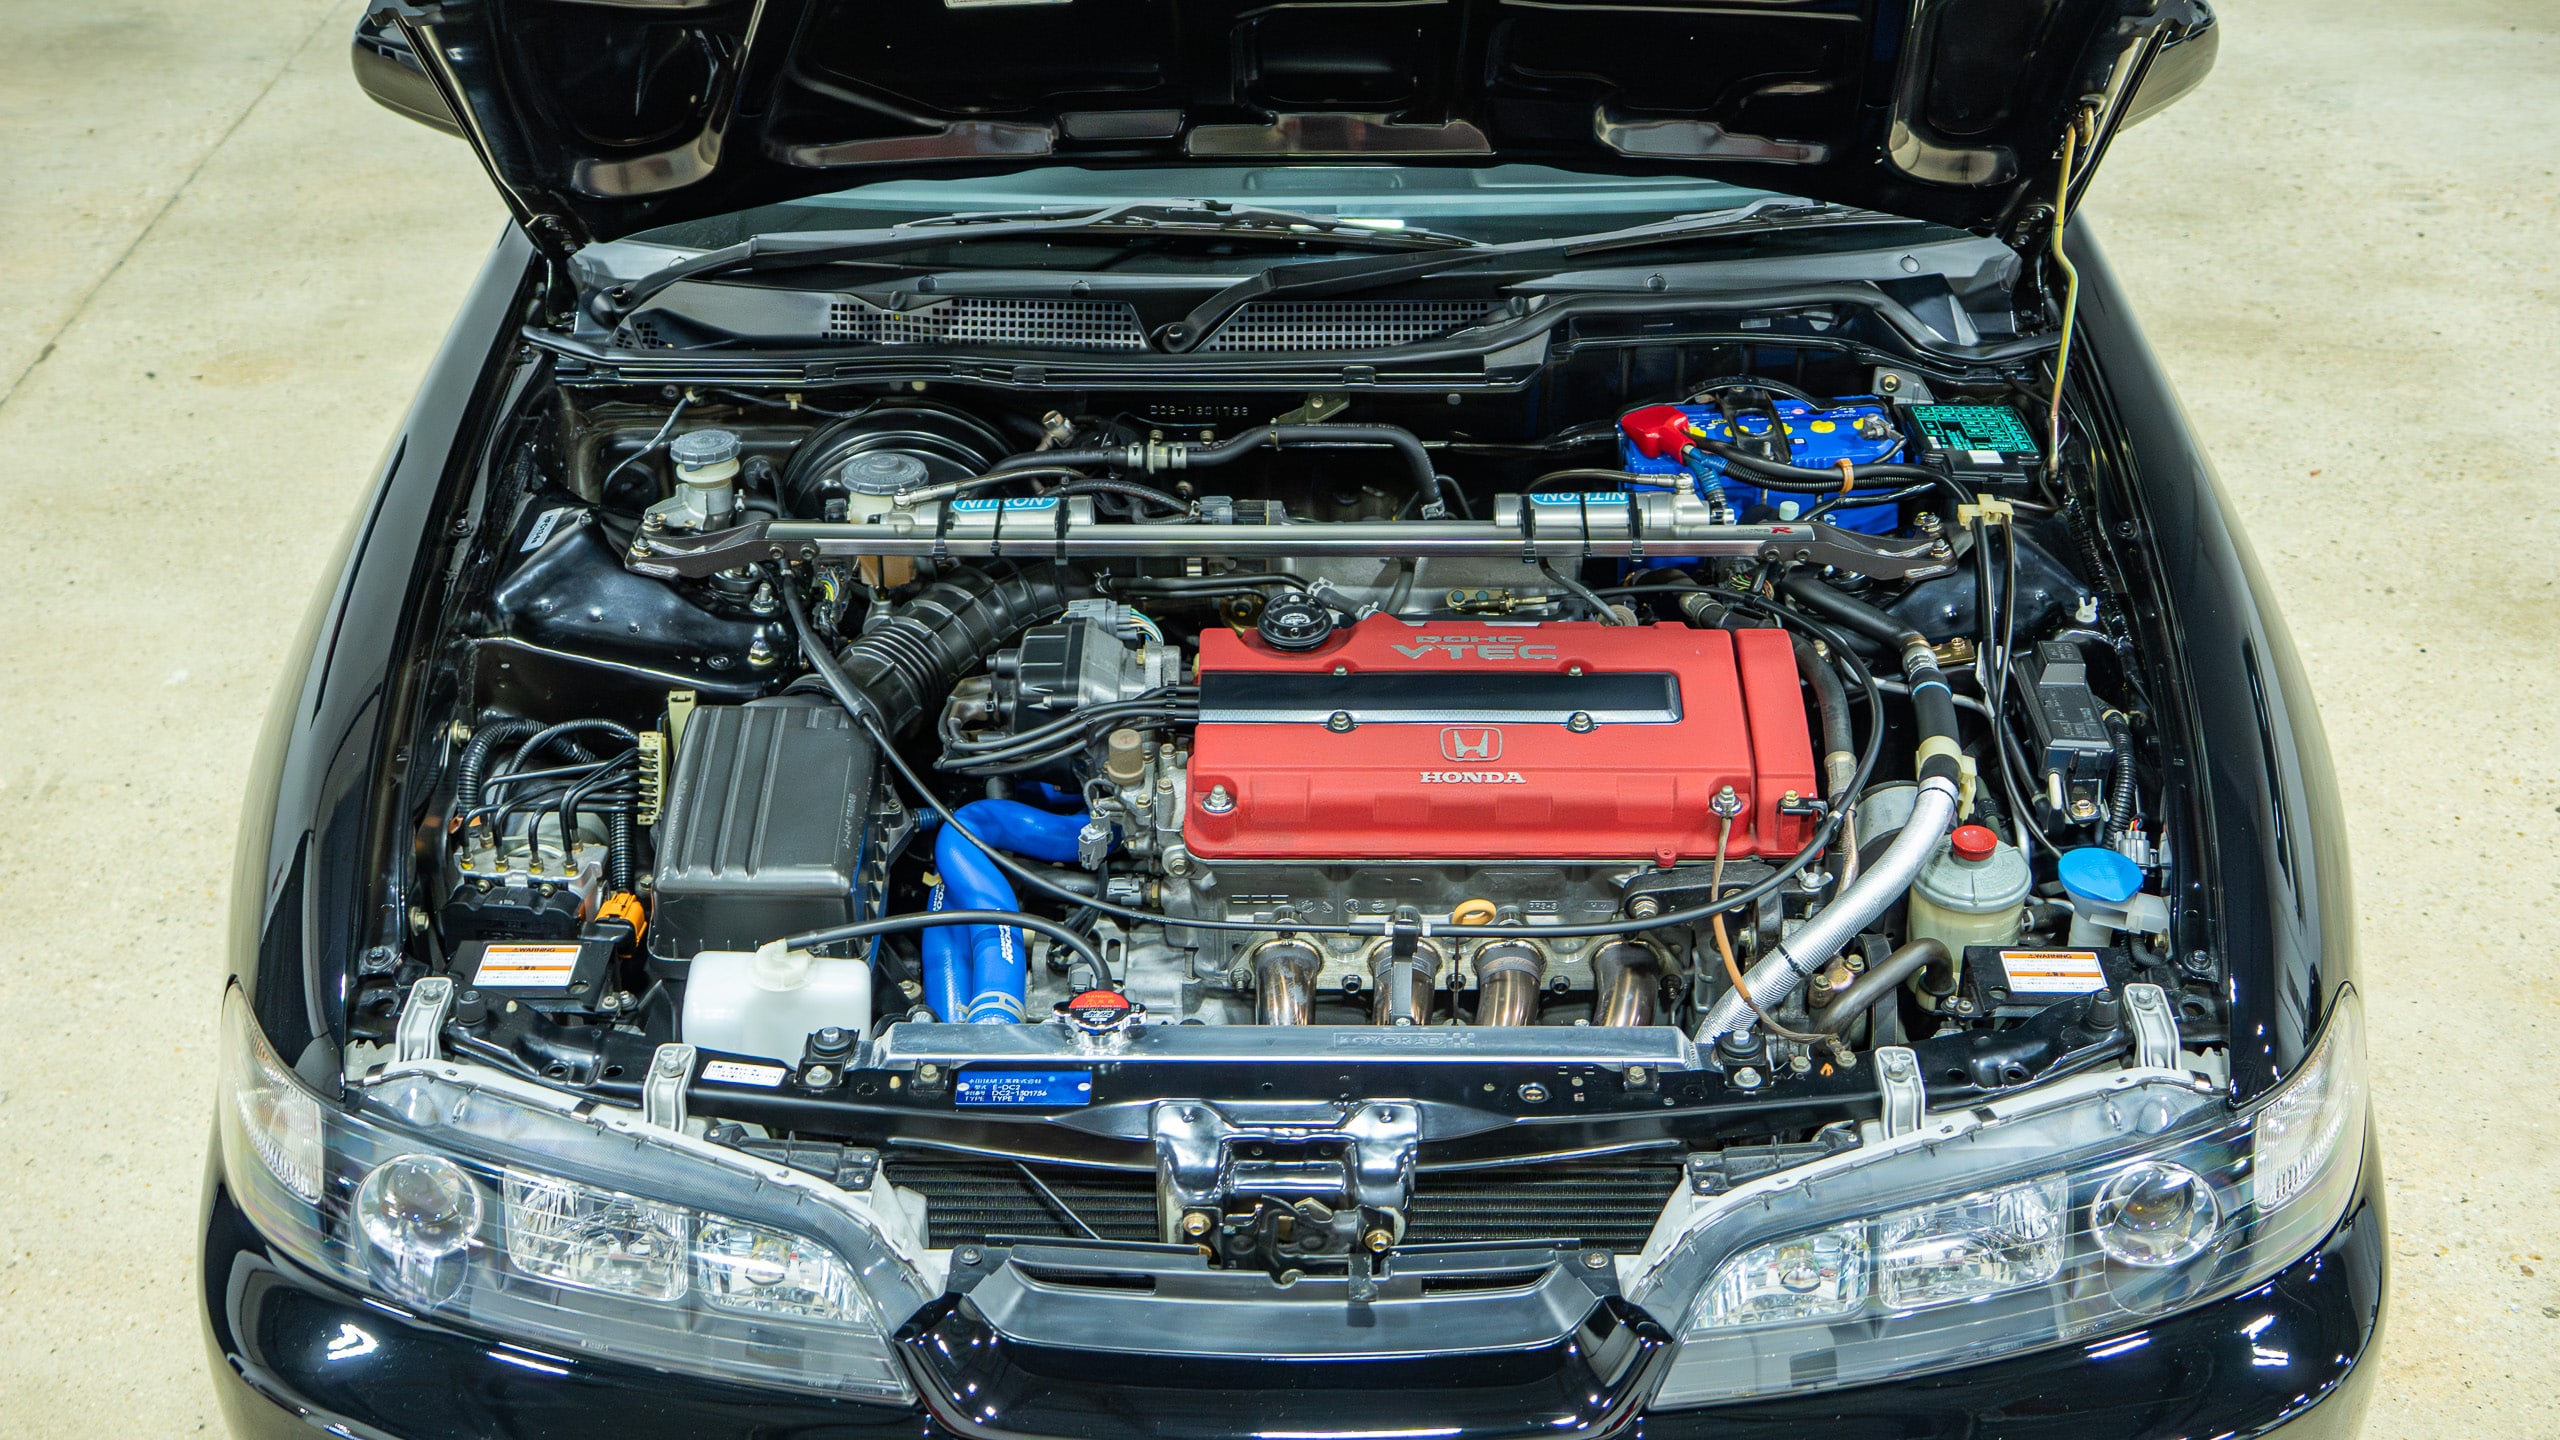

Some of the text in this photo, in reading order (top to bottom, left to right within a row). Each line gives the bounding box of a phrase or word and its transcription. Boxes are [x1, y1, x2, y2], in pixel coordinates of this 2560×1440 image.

[1415, 635, 1524, 643] DOHC
[1391, 644, 1557, 660] VTEC
[1420, 771, 1527, 784] HONDA
